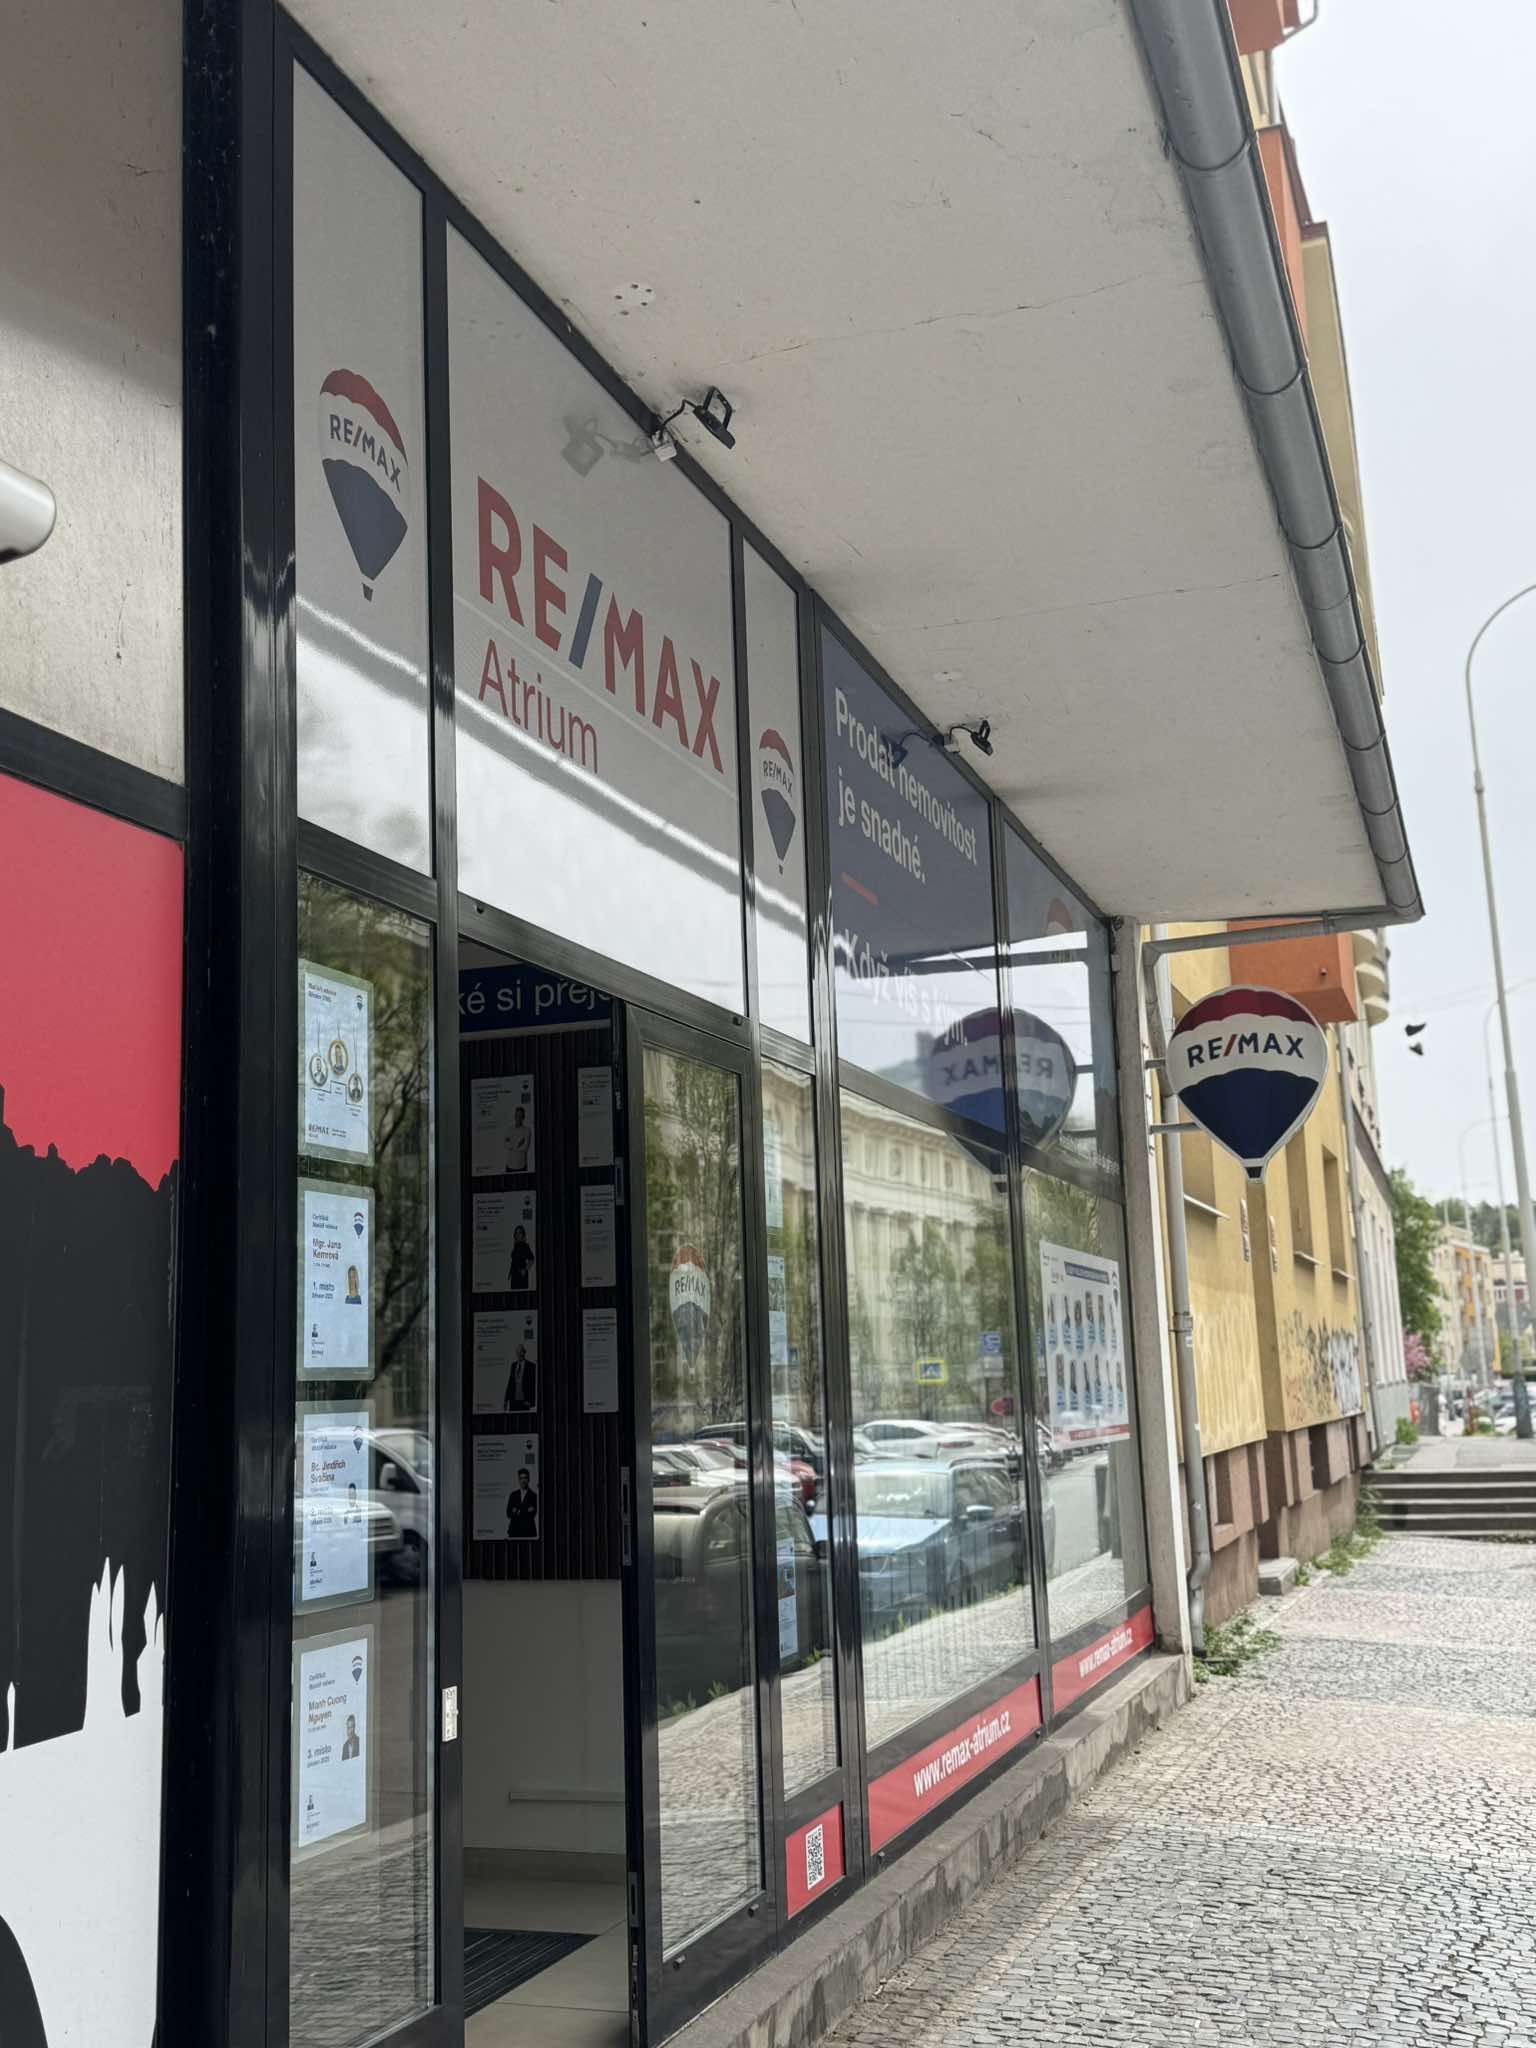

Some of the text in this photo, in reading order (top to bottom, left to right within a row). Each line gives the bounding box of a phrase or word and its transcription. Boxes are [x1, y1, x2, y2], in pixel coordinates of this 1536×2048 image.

[329, 413, 401, 494] RE/MAX
[478, 475, 724, 775] RE/MAX
[479, 639, 597, 774] Atrium
[762, 760, 793, 797] RE/MAX
[835, 687, 977, 866] Prodat nemovitost
[838, 765, 926, 884] je snadné.
[497, 979, 521, 1012] si
[845, 928, 891, 1005] Když
[1187, 1032, 1304, 1068] RE/MAX
[913, 1710, 1011, 1797] www.remax-atrium.cz
